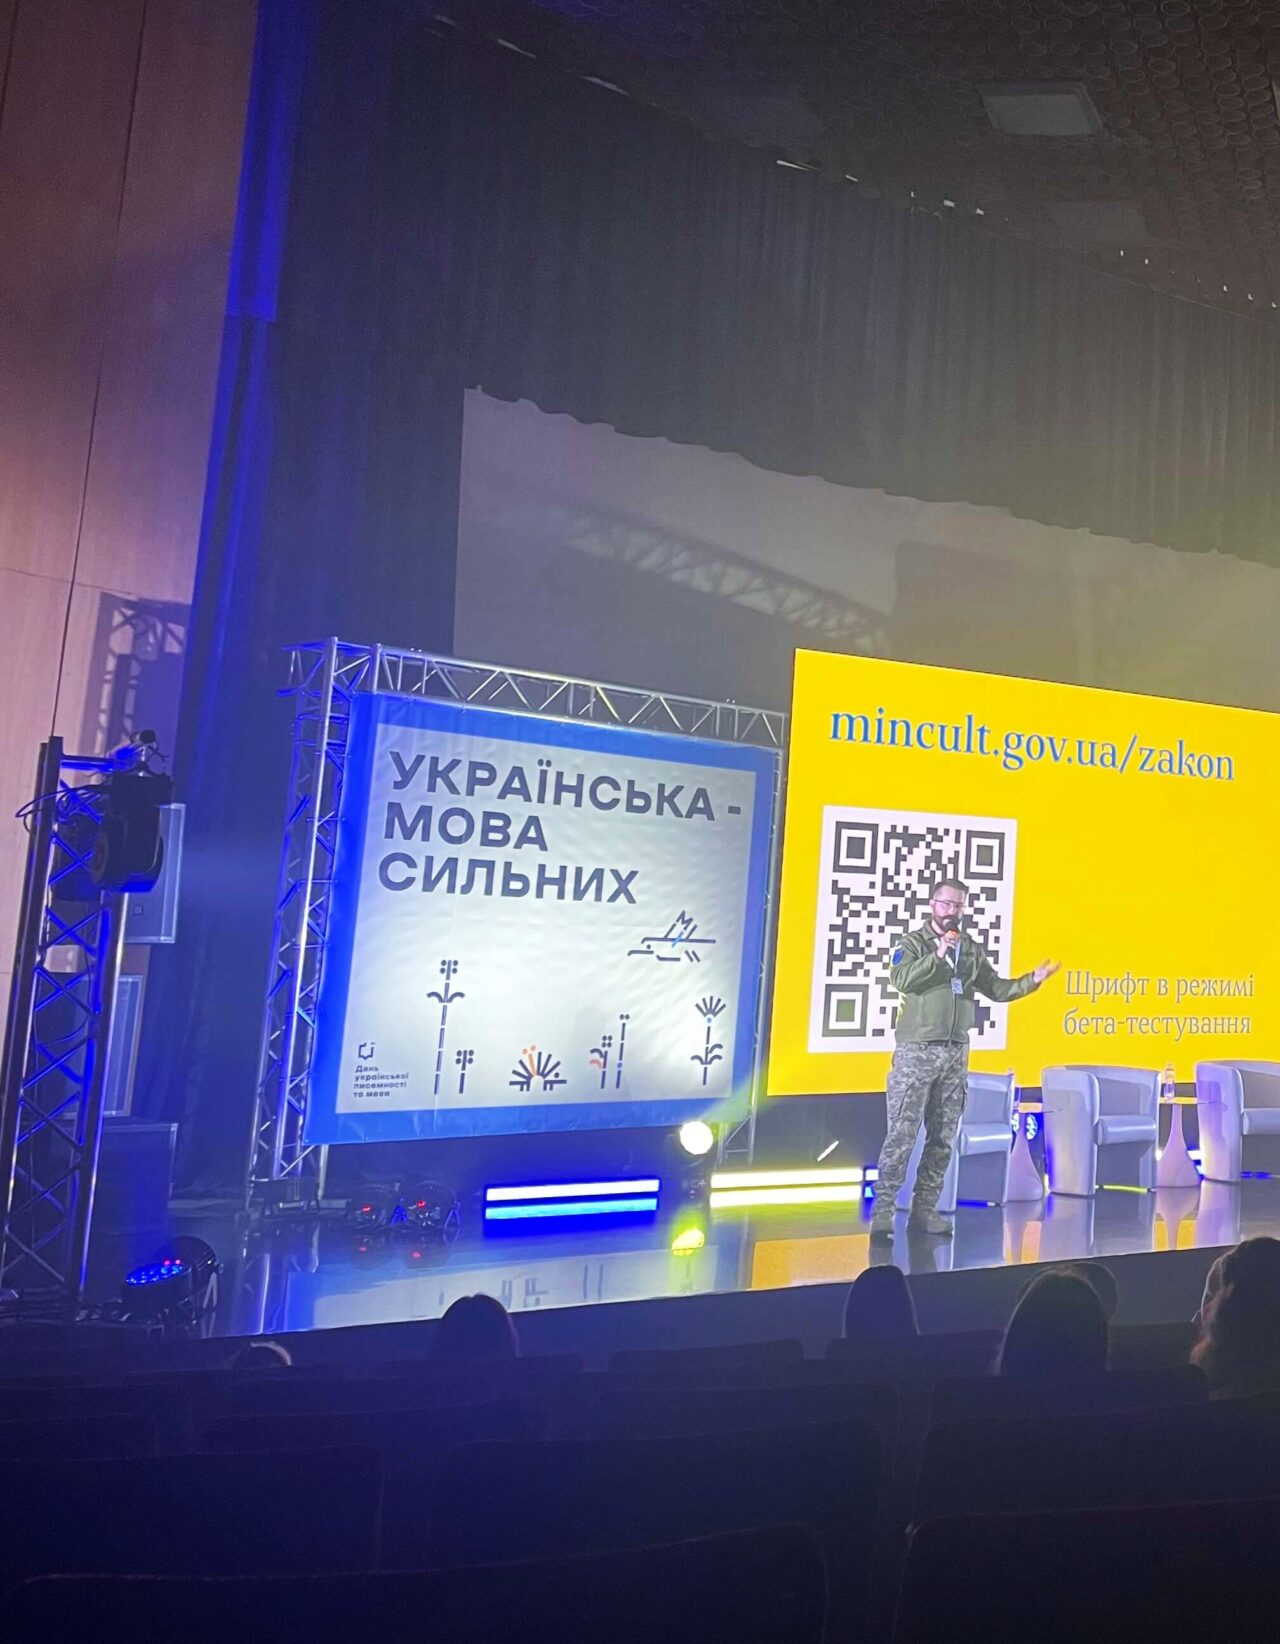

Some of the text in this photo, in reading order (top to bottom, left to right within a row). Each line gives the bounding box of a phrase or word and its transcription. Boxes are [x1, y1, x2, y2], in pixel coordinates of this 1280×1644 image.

[829, 707, 1235, 781] mincult.gov.ua/zakon
[389, 751, 715, 821] УКРАЇНСЬКА
[384, 802, 549, 852] МОВА
[378, 852, 639, 904] СИЛЬНИХ
[1066, 970, 1255, 1003] Шрифт в режимі
[1064, 1007, 1251, 1042] бета-тестування
[355, 1065, 379, 1073] День
